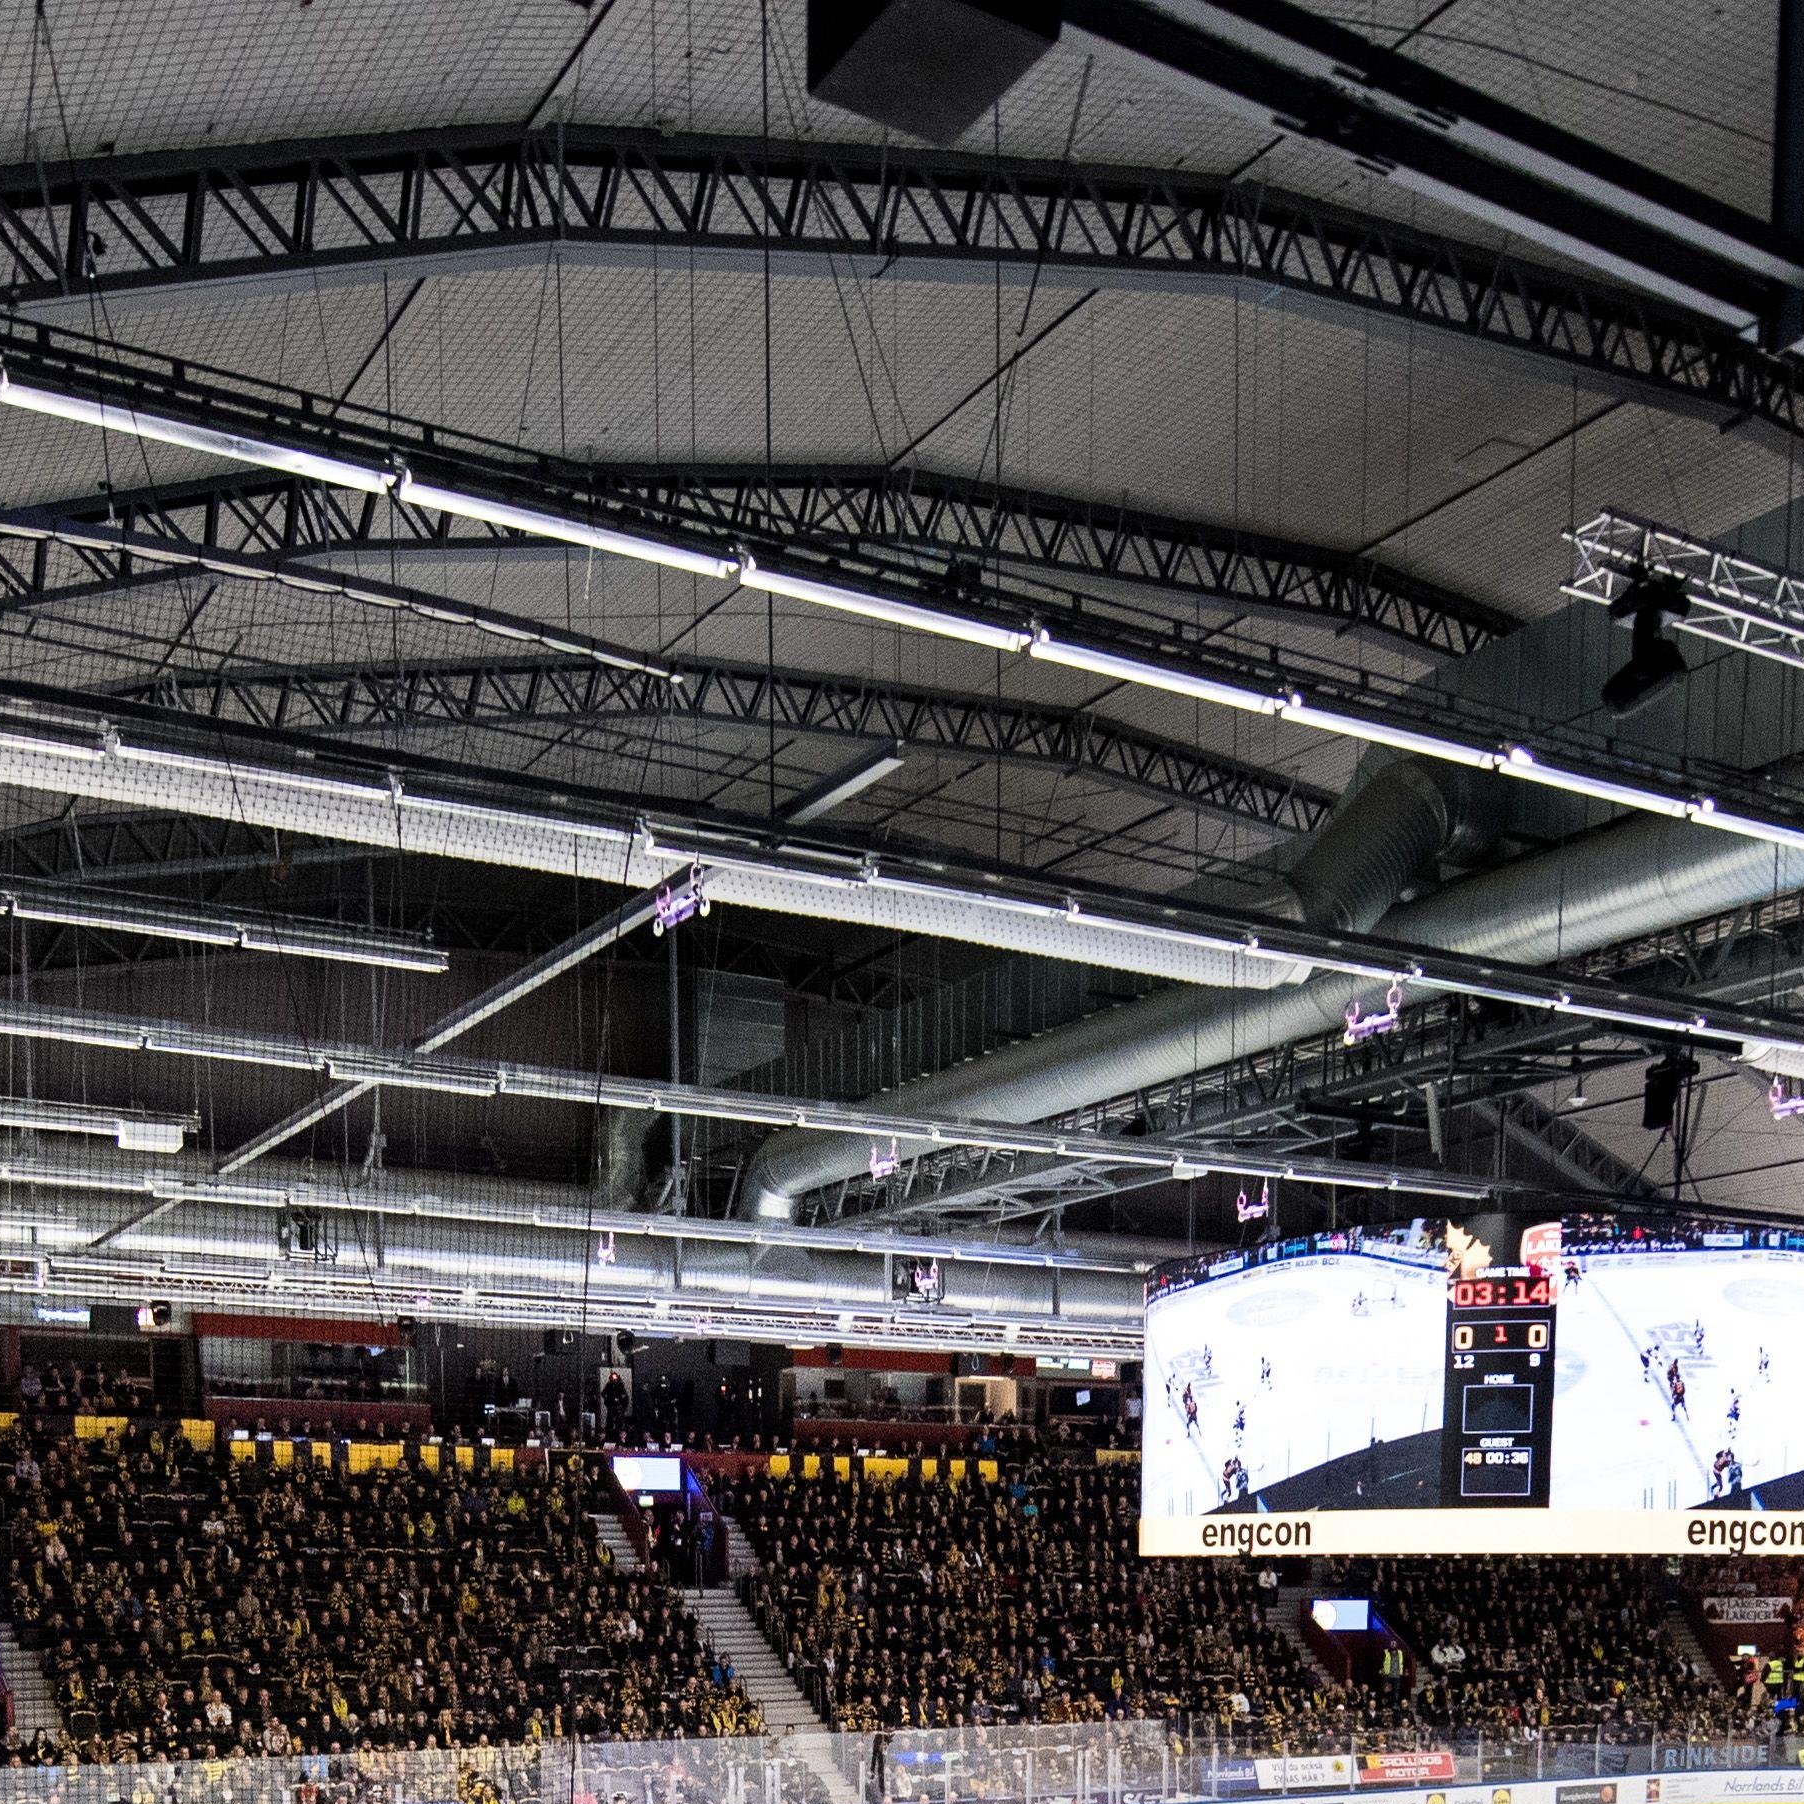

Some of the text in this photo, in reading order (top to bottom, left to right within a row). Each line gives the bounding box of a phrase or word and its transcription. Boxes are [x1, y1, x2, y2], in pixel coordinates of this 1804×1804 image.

[1455, 1280, 1548, 1305] 03:14
[1454, 1324, 1547, 1350] 0 1 0
[1454, 1353, 1540, 1368] 12 9
[1484, 1374, 1514, 1384] HOME
[1480, 1437, 1514, 1447] GUEST
[1201, 1517, 1313, 1553] engcon
[1385, 1768, 1430, 1777] MOTOR
[1725, 1776, 1804, 1793] Norrlands Bil
